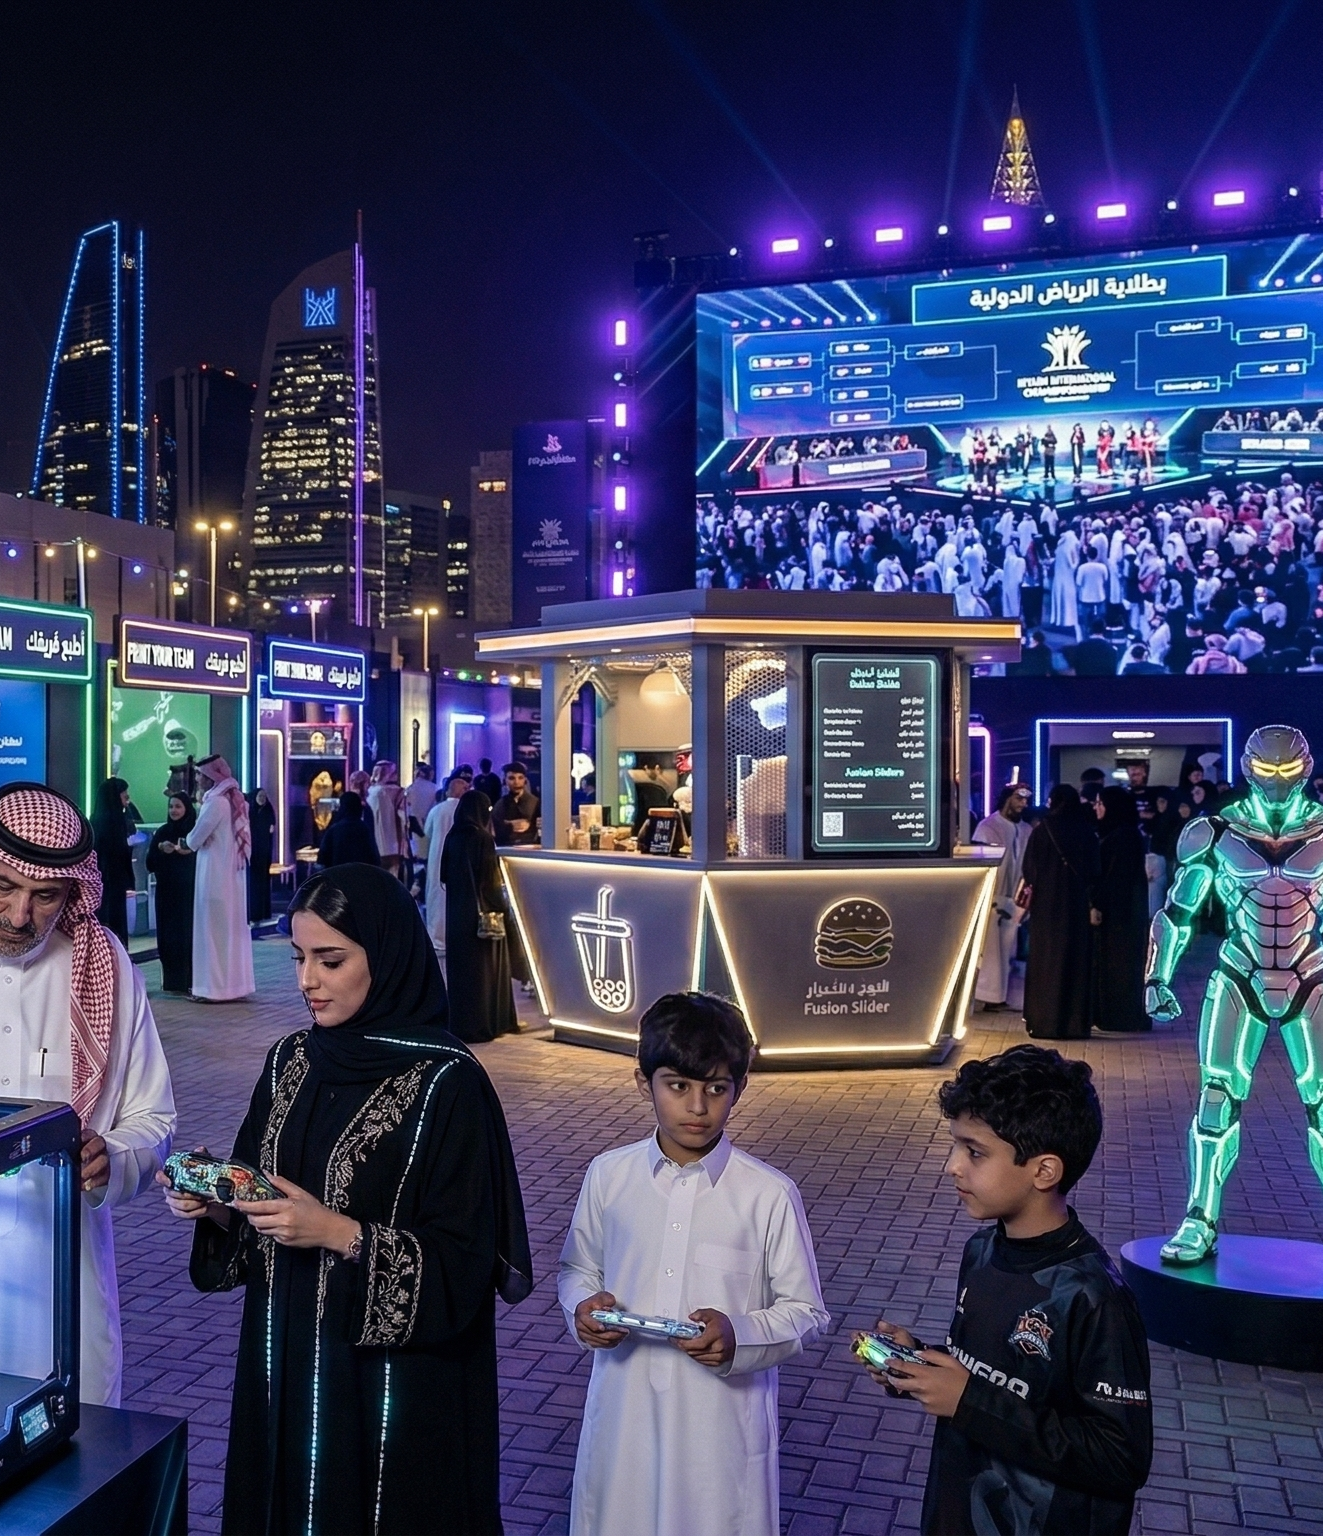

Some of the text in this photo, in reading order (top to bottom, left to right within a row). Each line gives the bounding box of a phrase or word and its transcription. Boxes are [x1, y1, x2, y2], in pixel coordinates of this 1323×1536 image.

[970, 284, 1034, 311] الدولية
[1038, 278, 1100, 305] الرياض
[804, 999, 890, 1015] Fusion Slider
